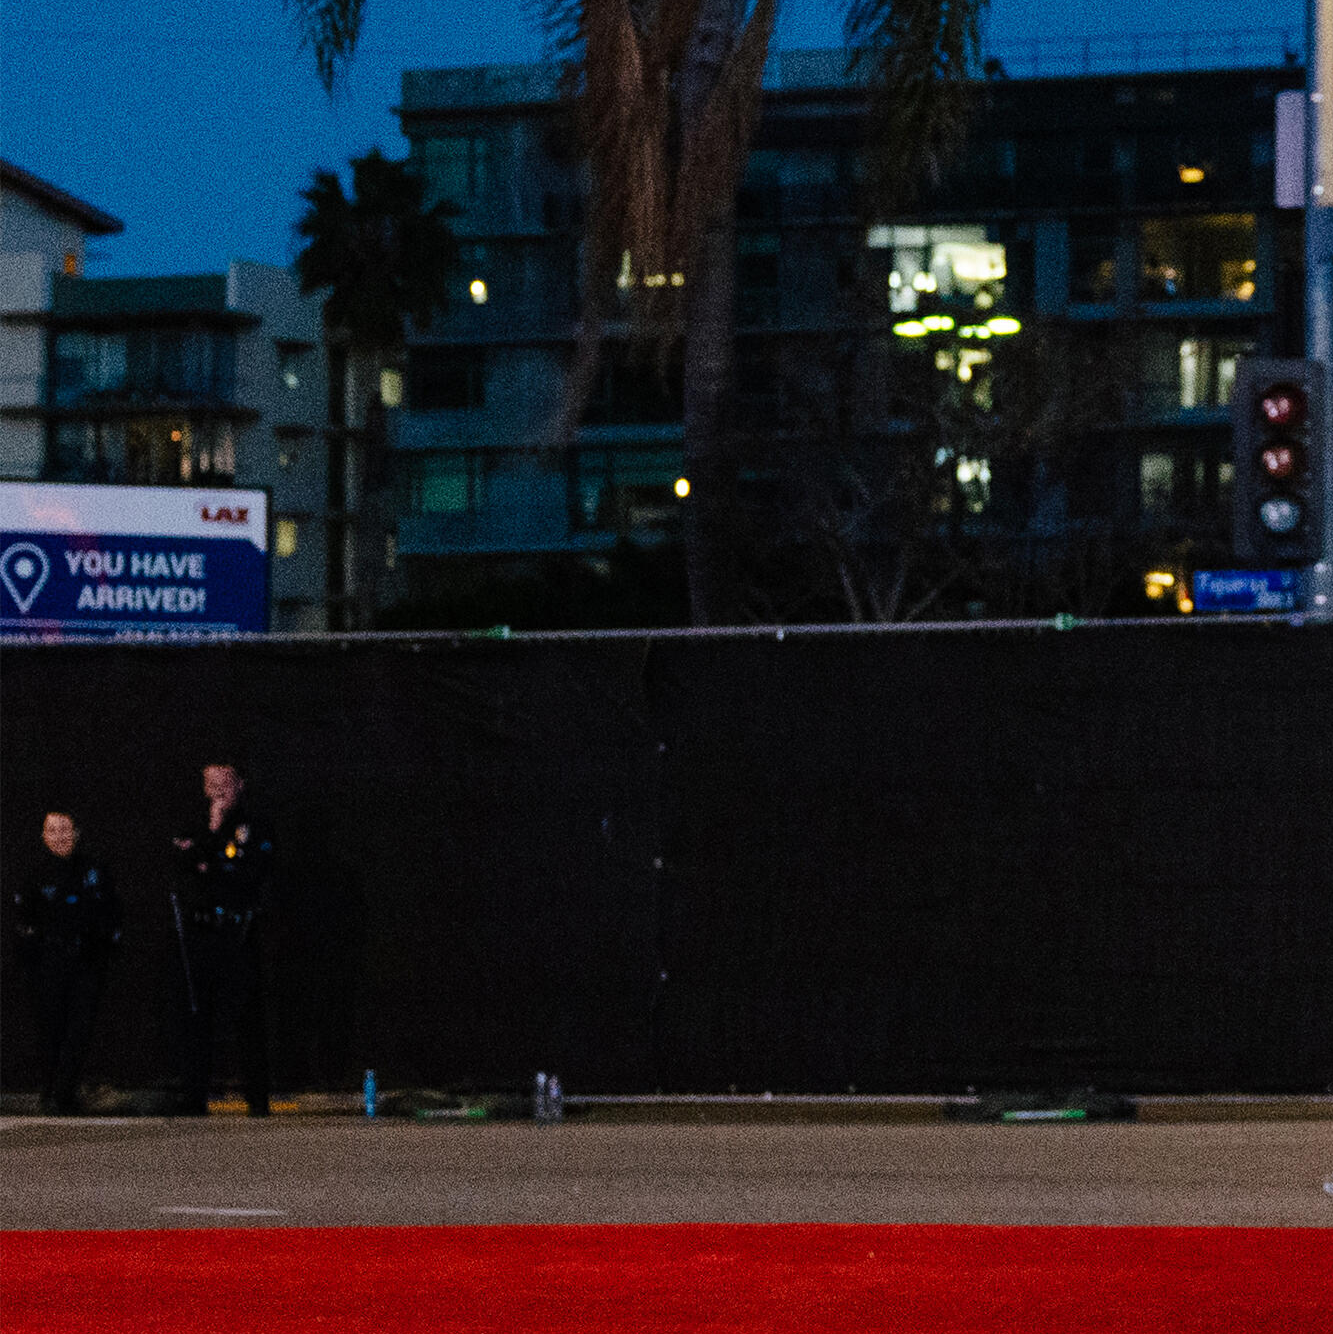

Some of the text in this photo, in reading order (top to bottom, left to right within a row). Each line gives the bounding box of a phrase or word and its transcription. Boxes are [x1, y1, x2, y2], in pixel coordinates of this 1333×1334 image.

[64, 550, 206, 579] YOU HAVE
[77, 584, 207, 612] ARRIVED!
